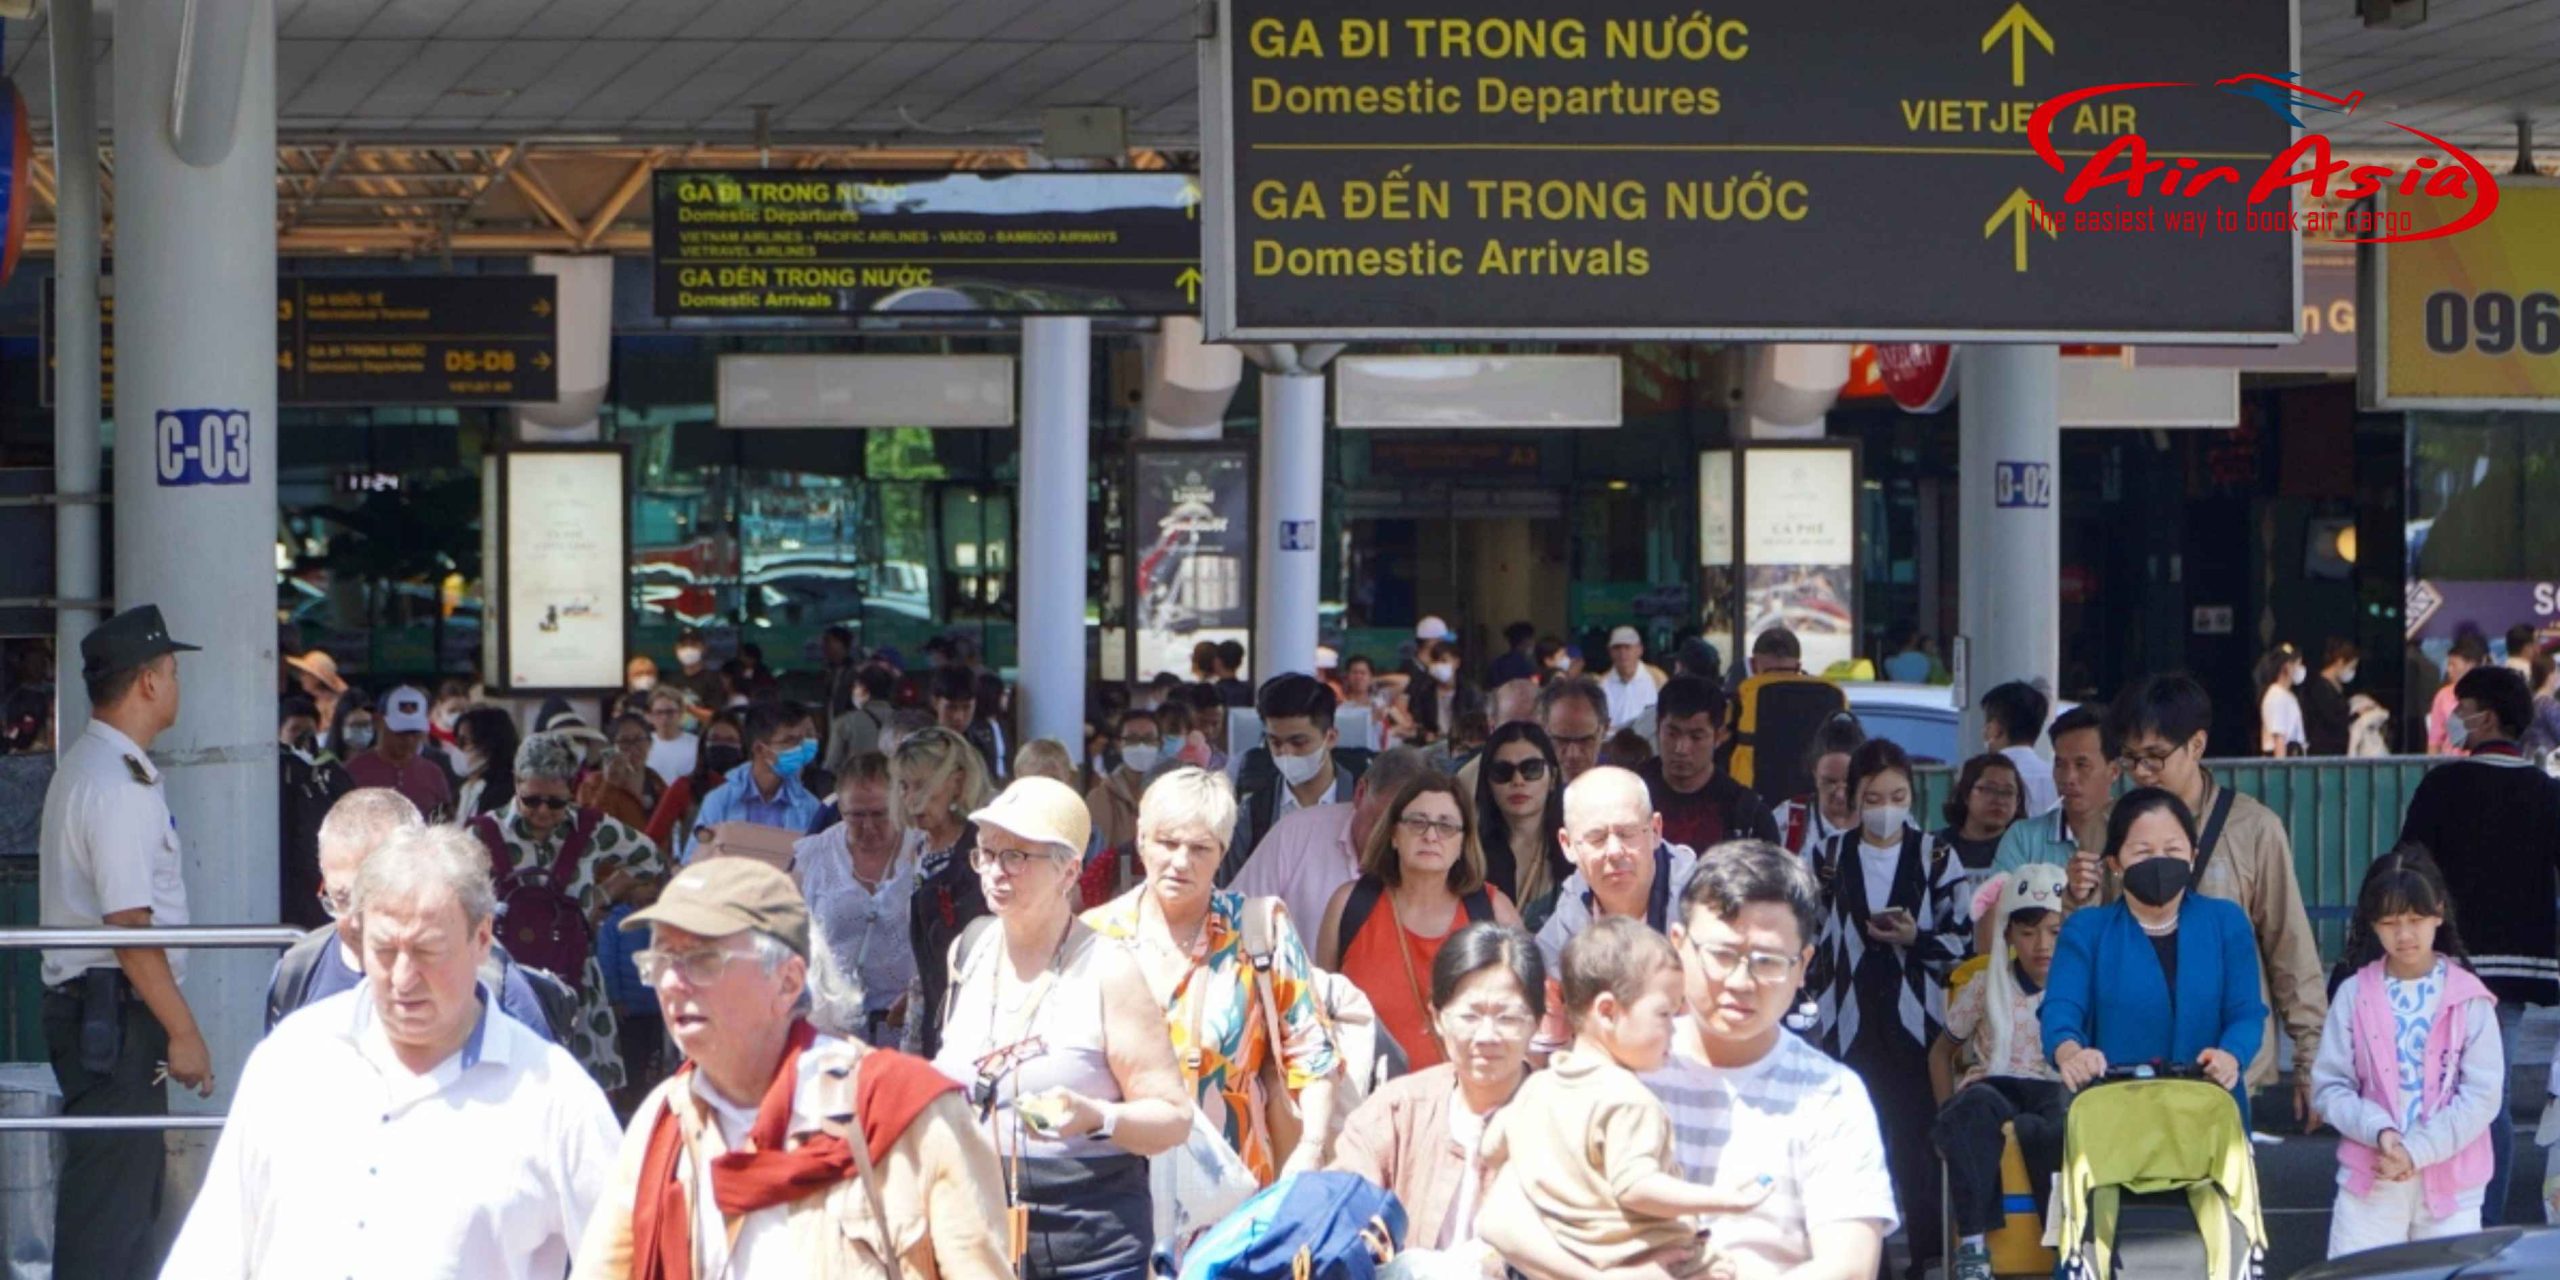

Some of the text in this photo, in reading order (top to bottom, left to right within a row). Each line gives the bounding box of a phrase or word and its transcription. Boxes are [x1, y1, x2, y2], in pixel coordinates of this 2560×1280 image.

[1250, 9, 1749, 60] GA ĐI TRONG NƯỚC
[1252, 78, 1721, 122] Domestic Departures
[1901, 100, 2137, 135] VIETJE AIR
[678, 183, 713, 202] GA
[747, 183, 829, 203] TRONG
[1252, 165, 1809, 221] GA ĐẾN TRONG NƯỚC
[679, 207, 859, 225] Domestic Departures
[679, 231, 739, 242] VIETNAM
[742, 231, 803, 242] AIRLINES
[814, 231, 864, 242] PACIFIC
[868, 231, 928, 243] AIRLINES
[939, 231, 986, 243] VASCO
[996, 231, 1055, 243] BAMBOO
[1058, 231, 1118, 243] AIRWAYS
[679, 245, 816, 257] VIETRAVEL AIRLINES
[1253, 240, 1650, 276] Domestic Arrivals
[679, 267, 714, 287] GA
[773, 267, 855, 287] TRONG
[862, 264, 932, 287] NƯỚC
[679, 291, 831, 307] Domestic Arrivals
[158, 414, 249, 480] C-03
[1999, 465, 2049, 504] B-02
[2534, 582, 2560, 616] S
